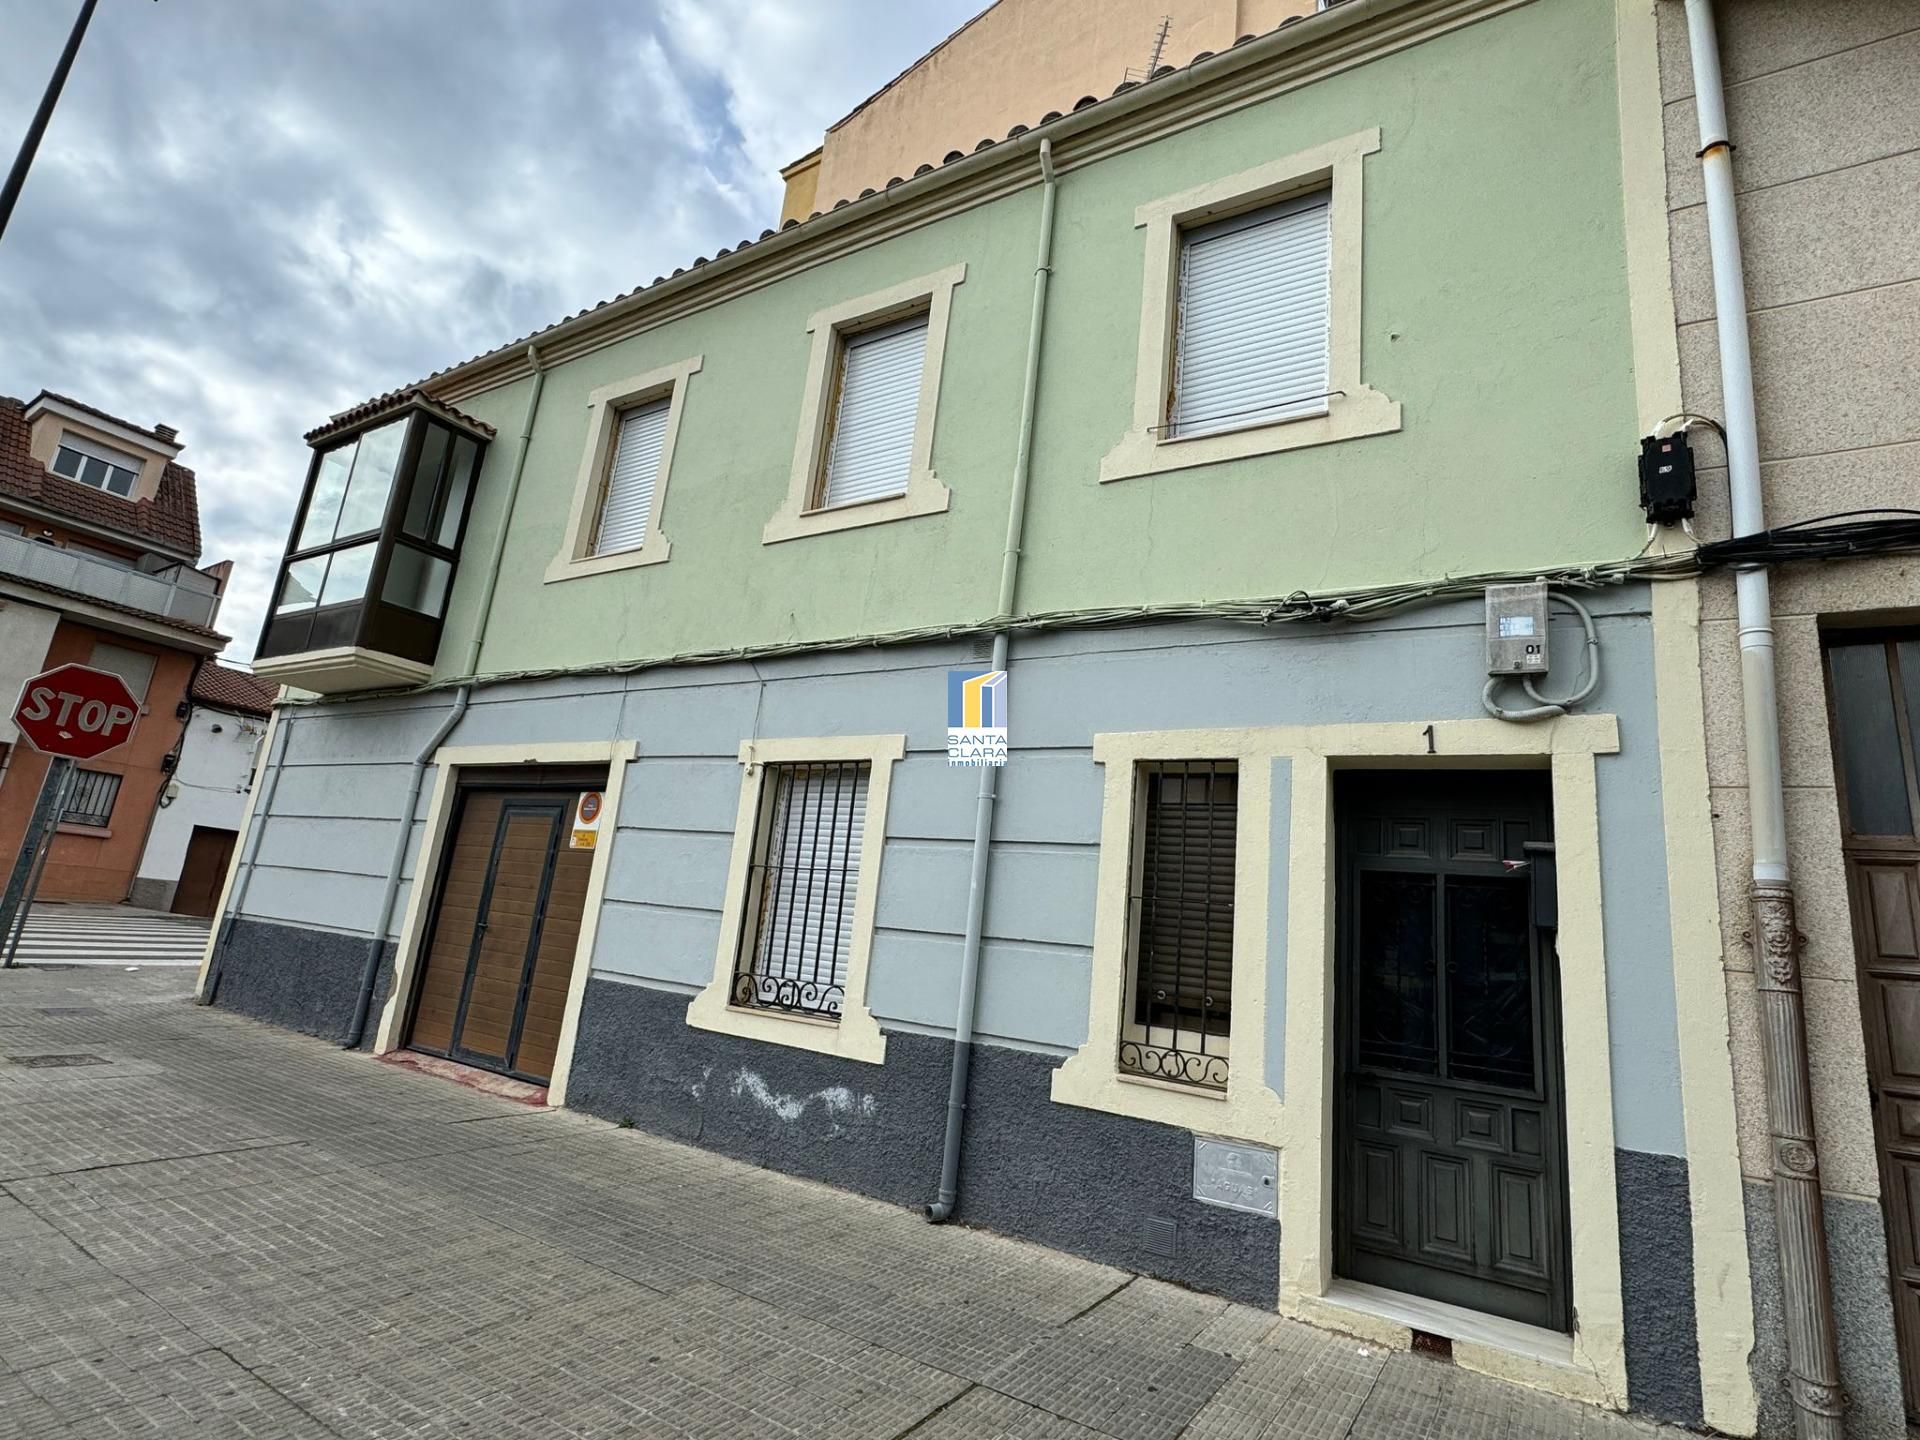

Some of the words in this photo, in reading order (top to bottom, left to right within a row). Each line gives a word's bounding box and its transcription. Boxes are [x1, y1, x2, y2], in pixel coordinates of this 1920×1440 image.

[1525, 644, 1541, 654] 01
[21, 687, 134, 737] STOP
[1422, 725, 1437, 754] 1
